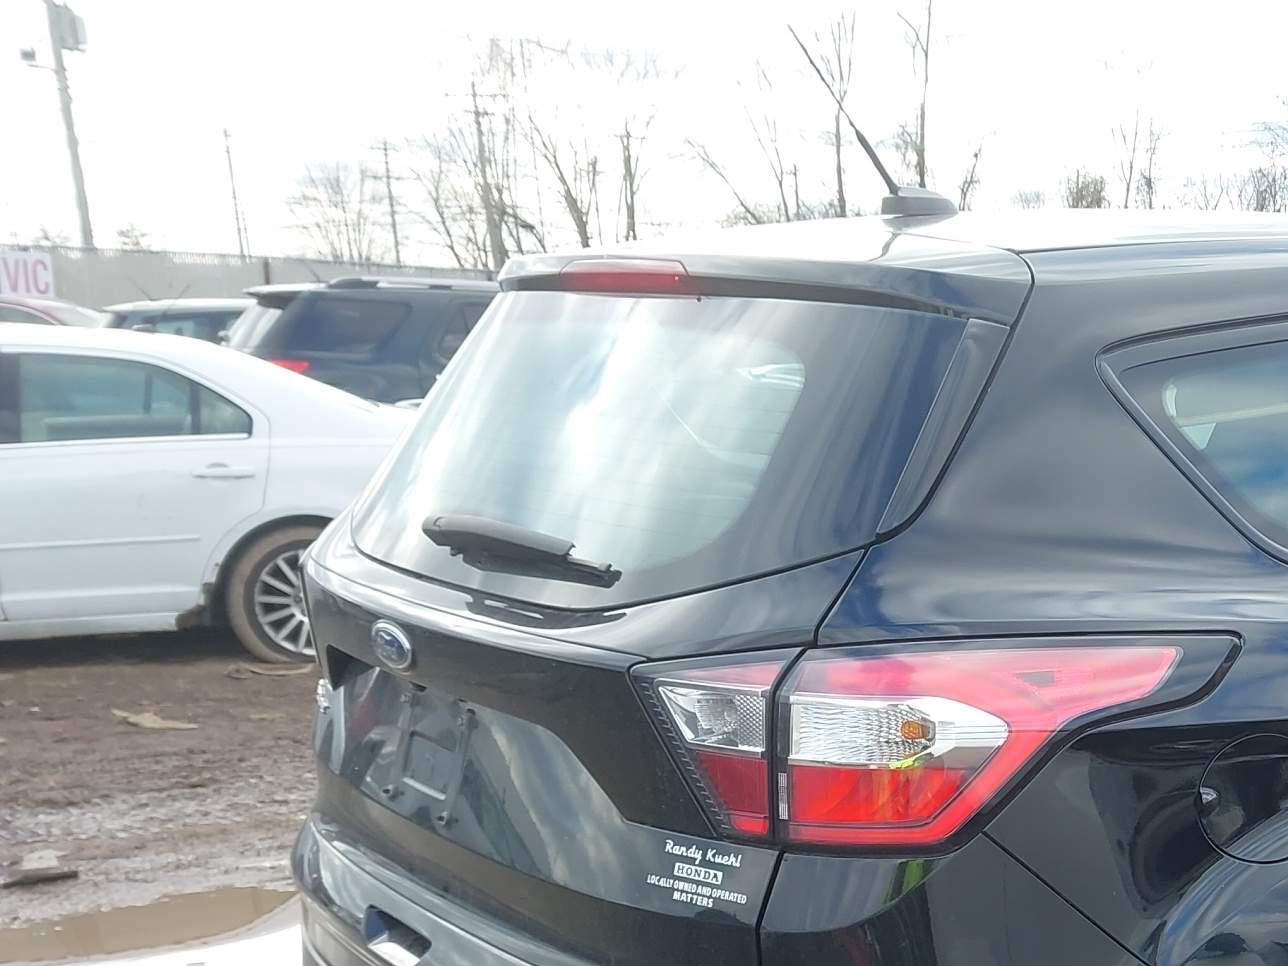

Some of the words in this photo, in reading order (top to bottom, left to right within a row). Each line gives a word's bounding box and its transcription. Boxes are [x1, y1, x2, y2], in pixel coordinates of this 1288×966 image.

[665, 839, 703, 865] Randy
[706, 848, 742, 867] Kuehl
[676, 864, 720, 883] HONDA
[647, 874, 673, 889] LOCALLY
[674, 881, 696, 894] OWNED
[696, 885, 711, 897] AND
[712, 888, 748, 904] OPERATED
[672, 890, 713, 908] MATTERS
